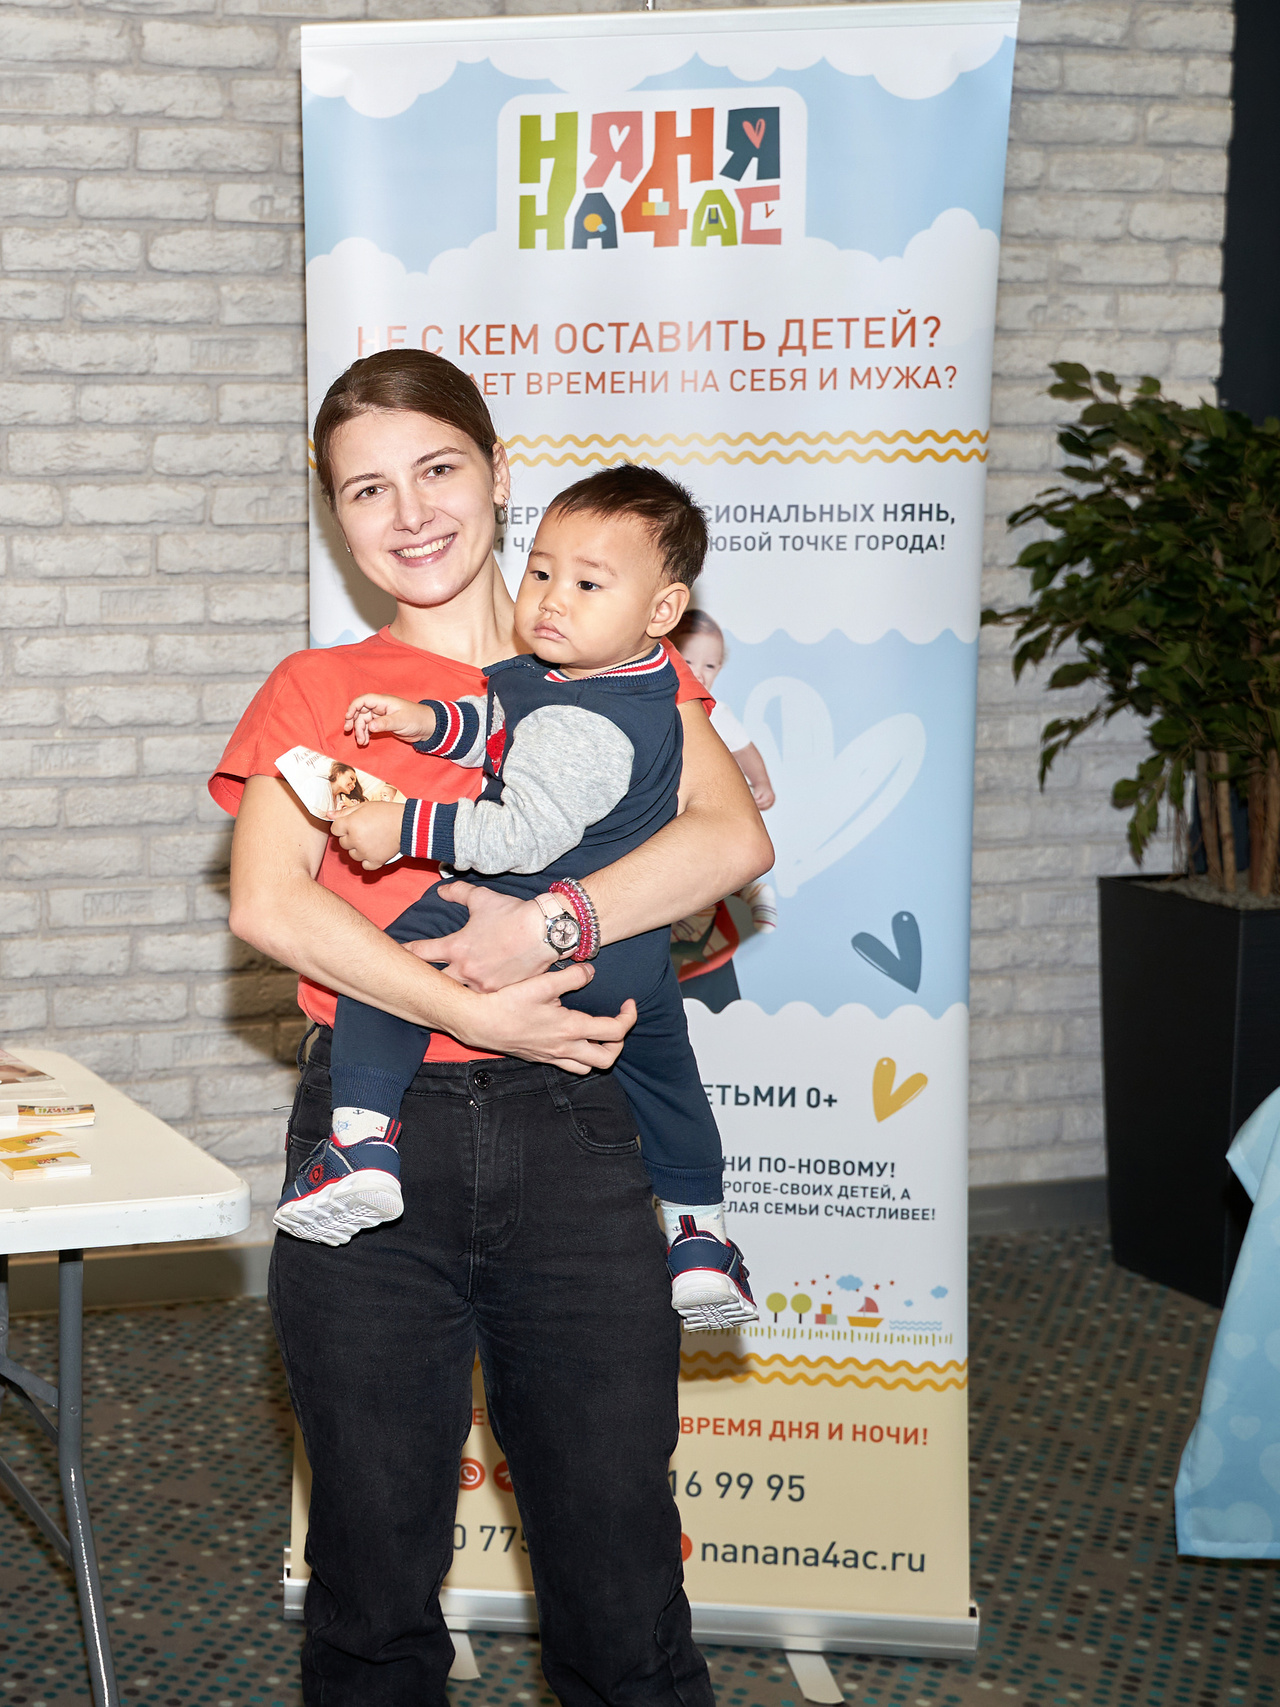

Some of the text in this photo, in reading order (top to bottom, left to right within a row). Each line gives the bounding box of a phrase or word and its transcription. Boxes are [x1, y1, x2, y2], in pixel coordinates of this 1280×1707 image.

[519, 106, 781, 189] НЯНЯ
[422, 325, 444, 356] С
[459, 324, 539, 355] КЕМ
[554, 320, 766, 354] ОСТАВИТЬ
[778, 308, 942, 357] ДЕТЕЙ?
[526, 370, 669, 395] ВРЕМЕНИ
[680, 369, 720, 393] НА
[729, 367, 808, 392] СЕБЯ
[819, 367, 838, 391] И
[850, 365, 958, 390] МУЖА?
[883, 503, 956, 525] НЯНЬ,
[779, 535, 848, 551] ТОЧКЕ
[855, 533, 946, 553] ГОРОДА!
[806, 1087, 838, 1108] 0+
[758, 1157, 895, 1178] ПО-НОВОМУ!
[837, 1184, 896, 1201] ДЕТЕЙ,
[901, 1188, 911, 1200] А
[764, 1202, 819, 1216] СЕМЬИ
[824, 1205, 935, 1221] СЧАСТЛИВЕЕ!
[680, 1416, 928, 1446] ВРЕМЯ ДНЯ И НОЧИ!
[715, 1472, 754, 1500] 99
[766, 1474, 805, 1502] 95
[701, 1541, 925, 1573] nanana4ac.ru
